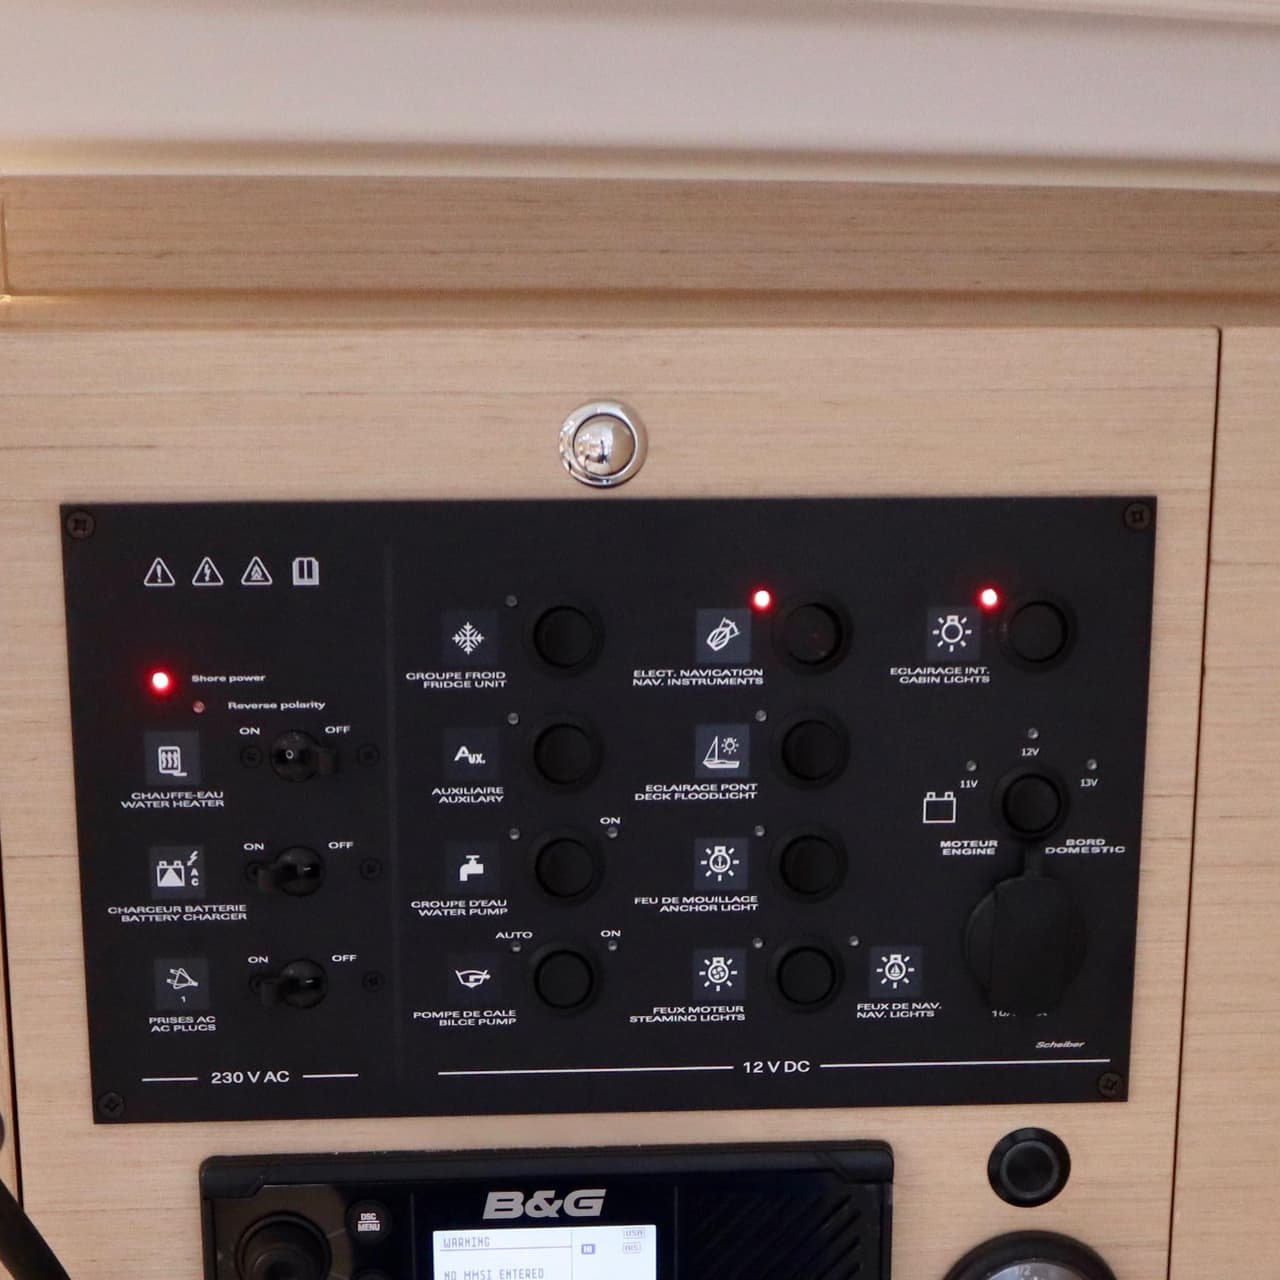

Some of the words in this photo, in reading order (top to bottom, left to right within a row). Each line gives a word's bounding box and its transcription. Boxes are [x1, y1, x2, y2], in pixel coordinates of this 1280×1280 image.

[406, 672, 463, 681] GROUPE
[465, 671, 506, 680] FROID
[633, 669, 677, 678] ELECT.
[680, 668, 763, 677] NAVIGATION
[890, 667, 963, 676] ECLAIRAGE
[964, 667, 990, 675] INT.
[192, 674, 226, 683] Shore
[228, 675, 266, 684] power
[632, 677, 664, 687] NAV.
[668, 677, 764, 686] INSTRUMENTS
[899, 676, 941, 684] CABIN
[944, 675, 990, 684] LIGHTS
[423, 680, 472, 689] FRIDGE
[474, 680, 507, 689] UNIT
[227, 702, 277, 710] Reverse
[280, 701, 326, 710] polarity
[239, 727, 261, 735] ON
[325, 726, 351, 734] OFF
[1021, 748, 1039, 756] 12V
[960, 780, 978, 788] 11V
[1080, 778, 1098, 787] 13V
[431, 786, 504, 796] AUXILIAIRE
[645, 784, 717, 793] ECLAIRAGE
[720, 783, 758, 792] PONT
[131, 791, 224, 800] CHAUFFE-EAU
[438, 795, 504, 804] AUXILARY
[635, 792, 671, 801] DECK
[673, 791, 757, 800] FLOODLIGHT
[121, 800, 170, 809] WATER
[173, 800, 224, 808] HEATER
[600, 817, 621, 825] ON
[328, 841, 354, 849] OFF
[940, 840, 998, 848] MOTEUR
[1066, 838, 1106, 846] BORD
[243, 843, 264, 851] ON
[1045, 846, 1126, 855] DOMESTIC
[942, 848, 996, 856] ENGINE
[411, 900, 467, 909] GROUPE
[469, 899, 508, 908] D'EAU
[634, 896, 660, 905] FEU
[662, 896, 681, 905] DE
[683, 895, 758, 904] MOUILLAGE
[184, 904, 247, 913] BATTERIE
[418, 908, 466, 917] WATER
[468, 907, 509, 916] PUMP
[659, 904, 719, 913] ANCHOR
[721, 903, 759, 912] LIGHT
[121, 914, 181, 922] BATTERY
[183, 912, 247, 921] CHARGER
[495, 931, 533, 940] AUTO
[600, 929, 621, 938] ON
[248, 956, 268, 964] ON
[331, 954, 357, 962] OFF
[652, 1006, 685, 1015] FEUX
[687, 1005, 745, 1014] MOTEUR
[856, 1003, 890, 1011] FEUX
[891, 1002, 909, 1011] DE
[911, 1002, 942, 1010] NAV.
[413, 1011, 460, 1019] POMPE
[462, 1010, 481, 1018] DE
[483, 1009, 517, 1018] CALE
[629, 1014, 697, 1023] STEAMING
[700, 1013, 745, 1022] LIGHTS
[856, 1011, 887, 1019] NAV.
[890, 1010, 935, 1018] LIGHTS
[149, 1016, 194, 1025] PRISES
[197, 1015, 216, 1023] AC
[439, 1018, 475, 1027] BILGE
[478, 1018, 517, 1026] PUMP
[151, 1024, 170, 1032] AC
[173, 1023, 216, 1032] PLUGS
[743, 1061, 763, 1074] 12
[765, 1061, 781, 1073] V
[783, 1060, 811, 1073] DC
[211, 1072, 244, 1084] 230
[247, 1071, 262, 1083] V
[263, 1071, 290, 1083] AC
[482, 1188, 607, 1220] B&G
[443, 1237, 491, 1249] WARNING
[463, 1269, 493, 1280] MMSI
[499, 1268, 544, 1280] ENTERED
